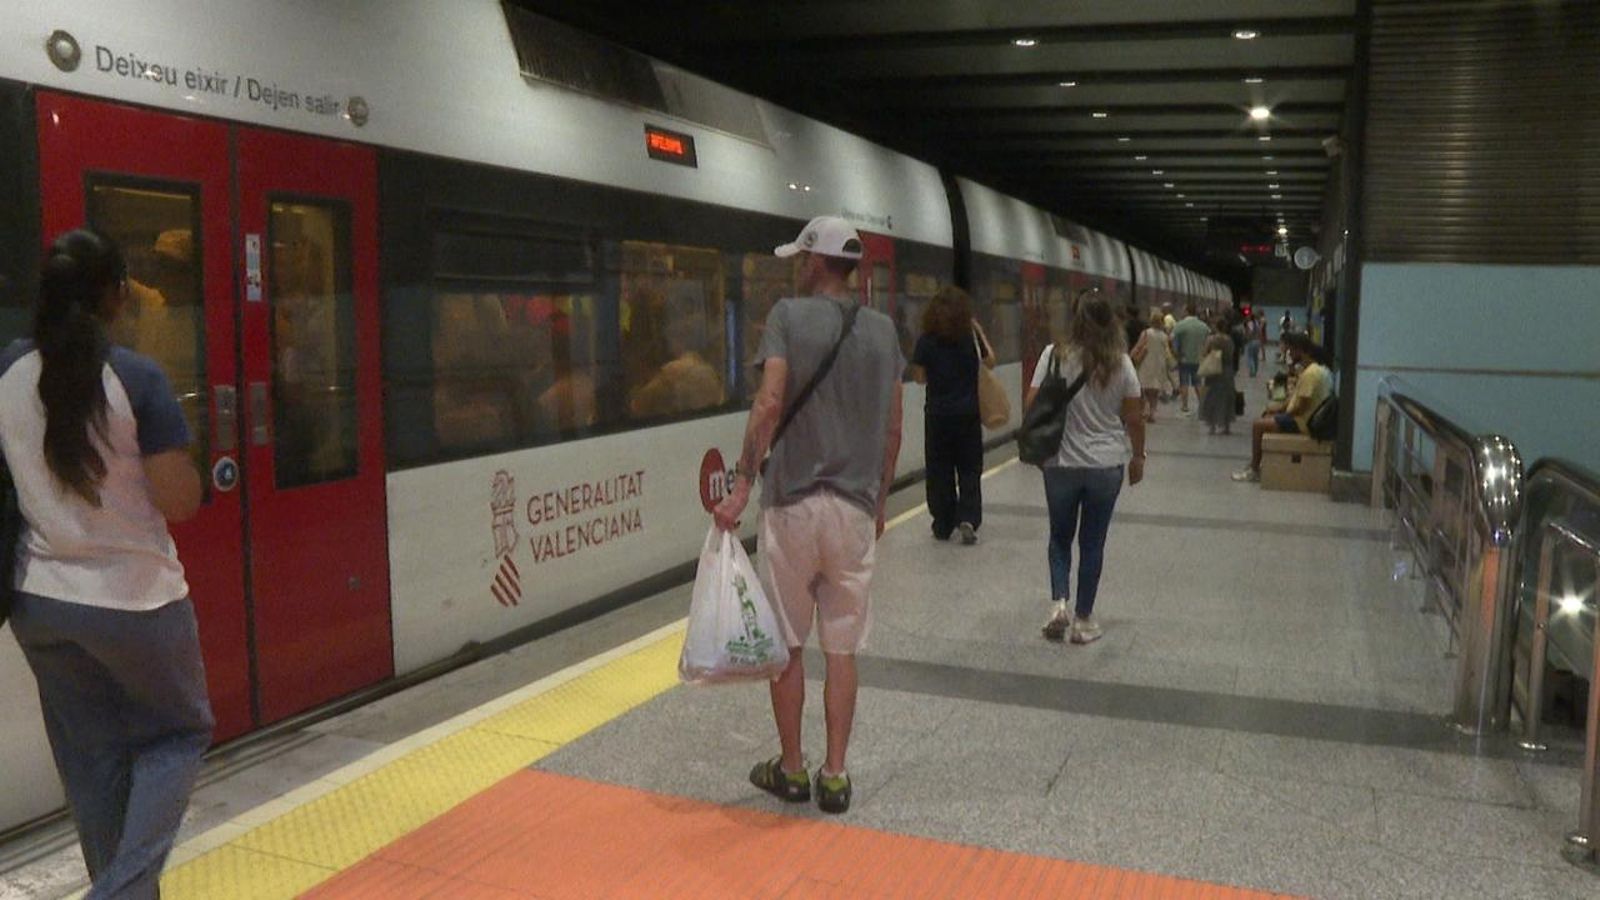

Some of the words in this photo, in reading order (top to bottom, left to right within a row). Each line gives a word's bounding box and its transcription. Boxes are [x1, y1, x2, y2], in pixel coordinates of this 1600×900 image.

[96, 45, 177, 87] Deixeu
[185, 67, 227, 94] eixir
[233, 75, 240, 98] /
[247, 78, 300, 110] Dejen
[527, 470, 645, 525] GENERALITAT
[530, 508, 643, 563] VALENCIANA
